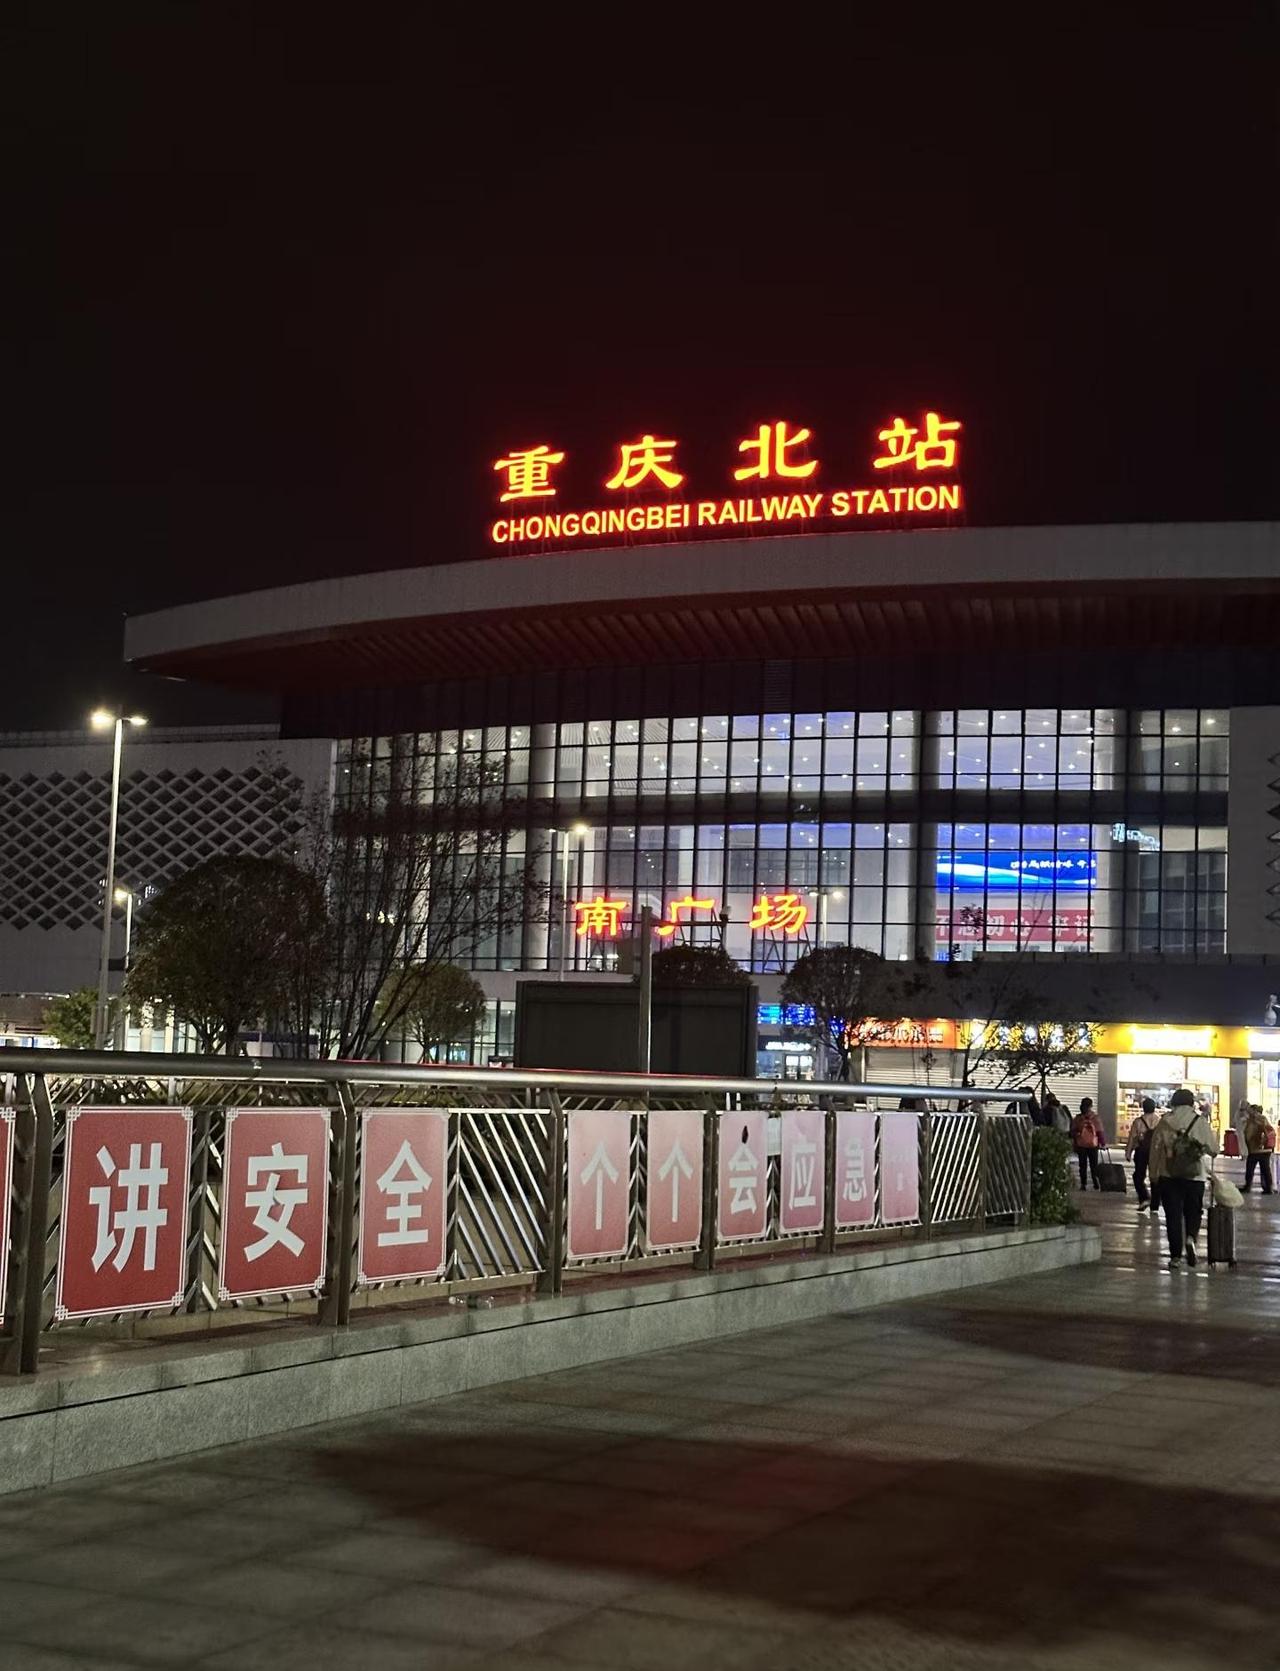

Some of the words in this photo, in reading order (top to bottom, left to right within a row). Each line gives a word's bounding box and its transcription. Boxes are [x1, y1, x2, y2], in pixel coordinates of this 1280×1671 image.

[493, 412, 963, 503] 重庆北站
[491, 503, 691, 545] CHONGQINGBEI
[697, 491, 824, 527] RAILWAY
[830, 484, 960, 517] STATION
[575, 894, 809, 937] 南广场
[89, 1140, 433, 1273] 讲安全
